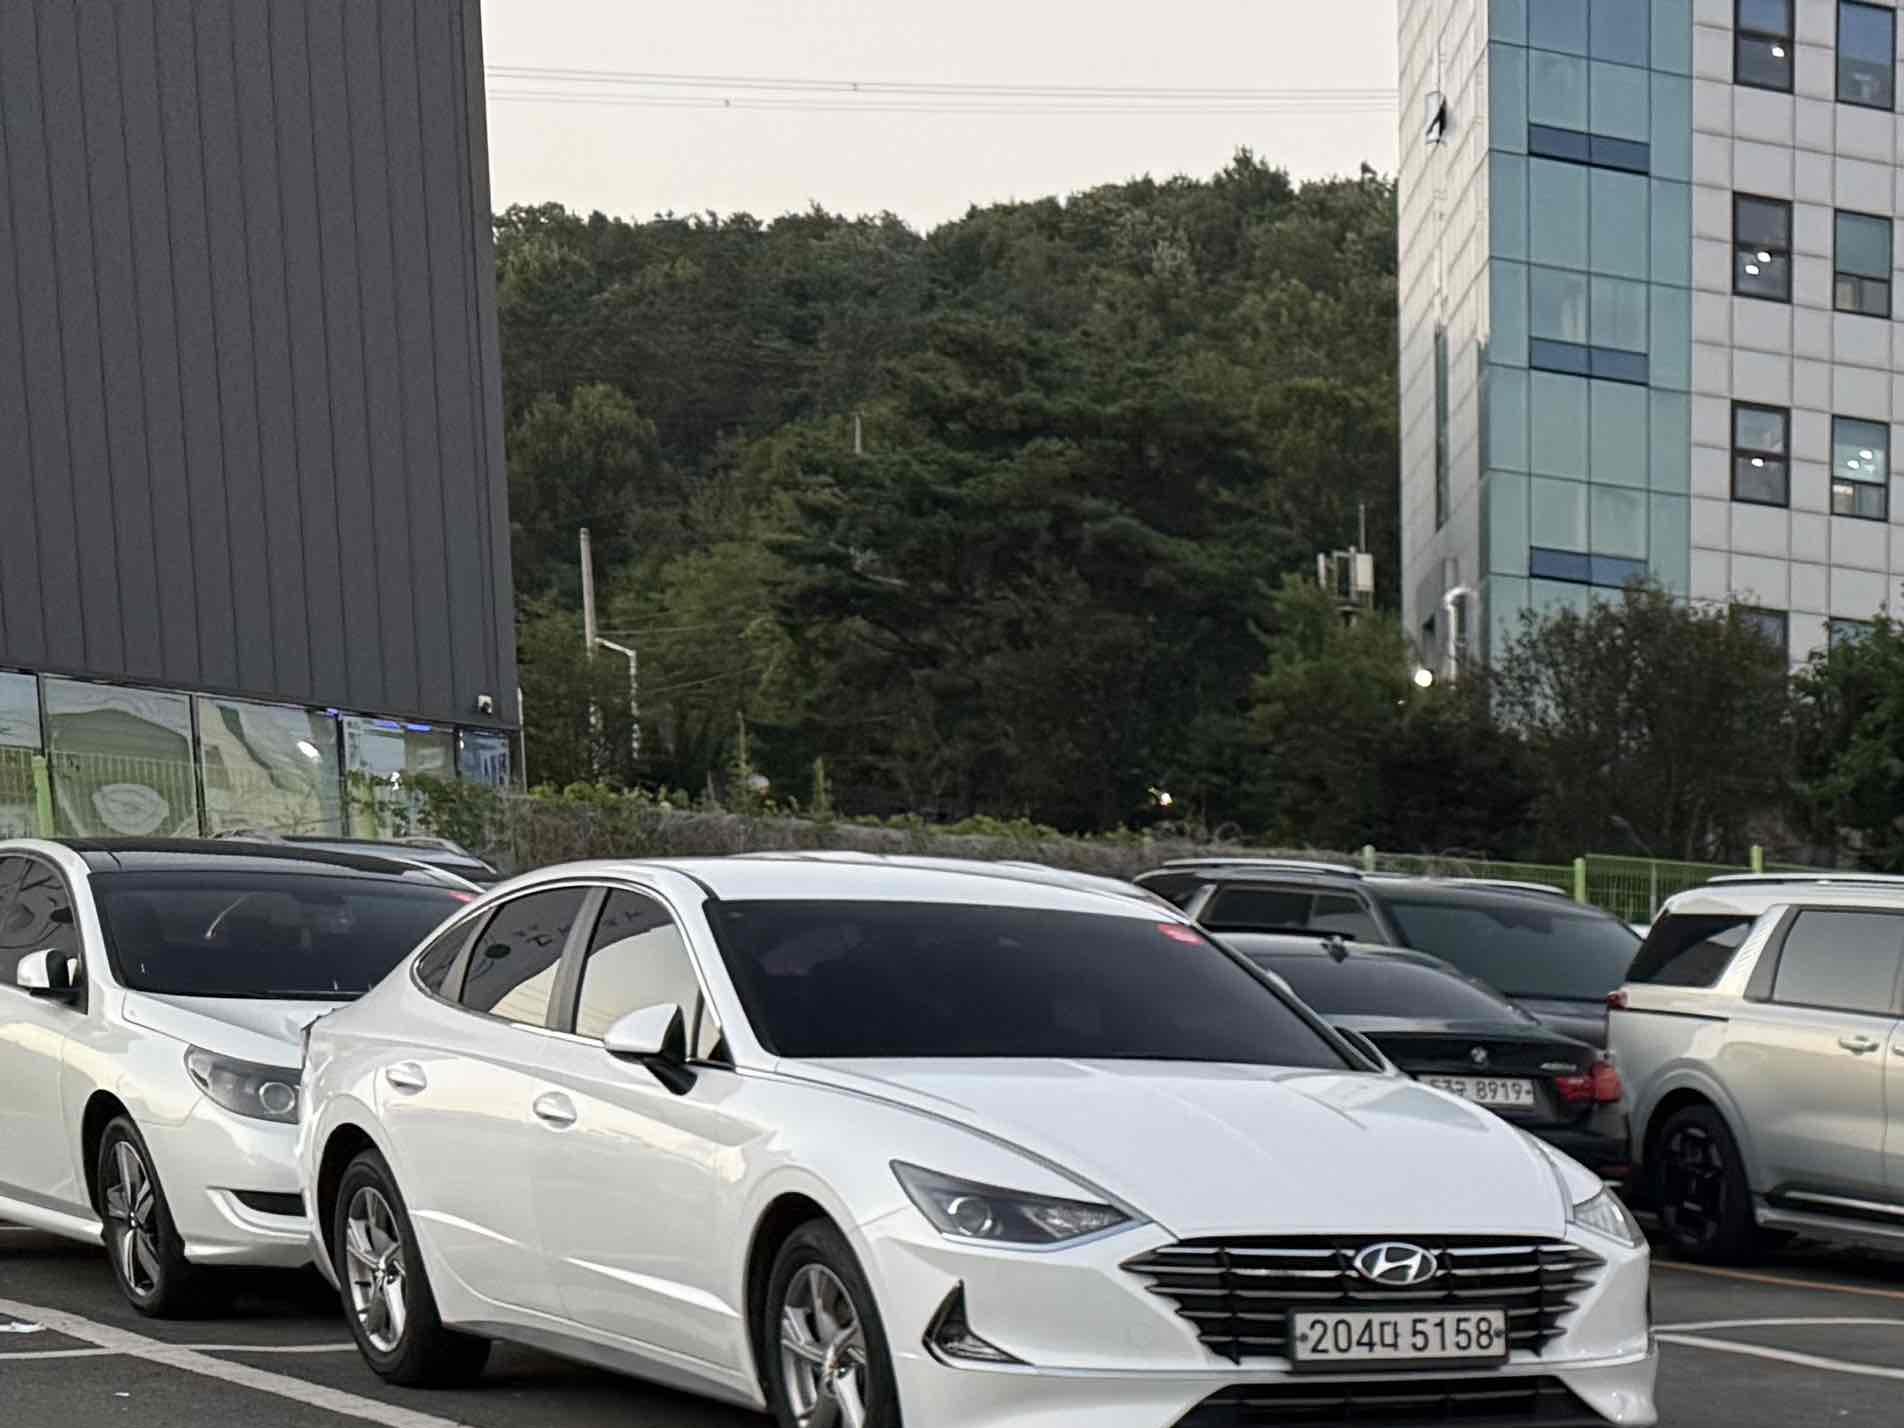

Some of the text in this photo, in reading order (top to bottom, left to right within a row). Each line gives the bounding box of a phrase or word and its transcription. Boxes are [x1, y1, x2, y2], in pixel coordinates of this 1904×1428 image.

[1475, 1080, 1522, 1101] 8919
[1309, 1317, 1494, 1353] 204다 5158
